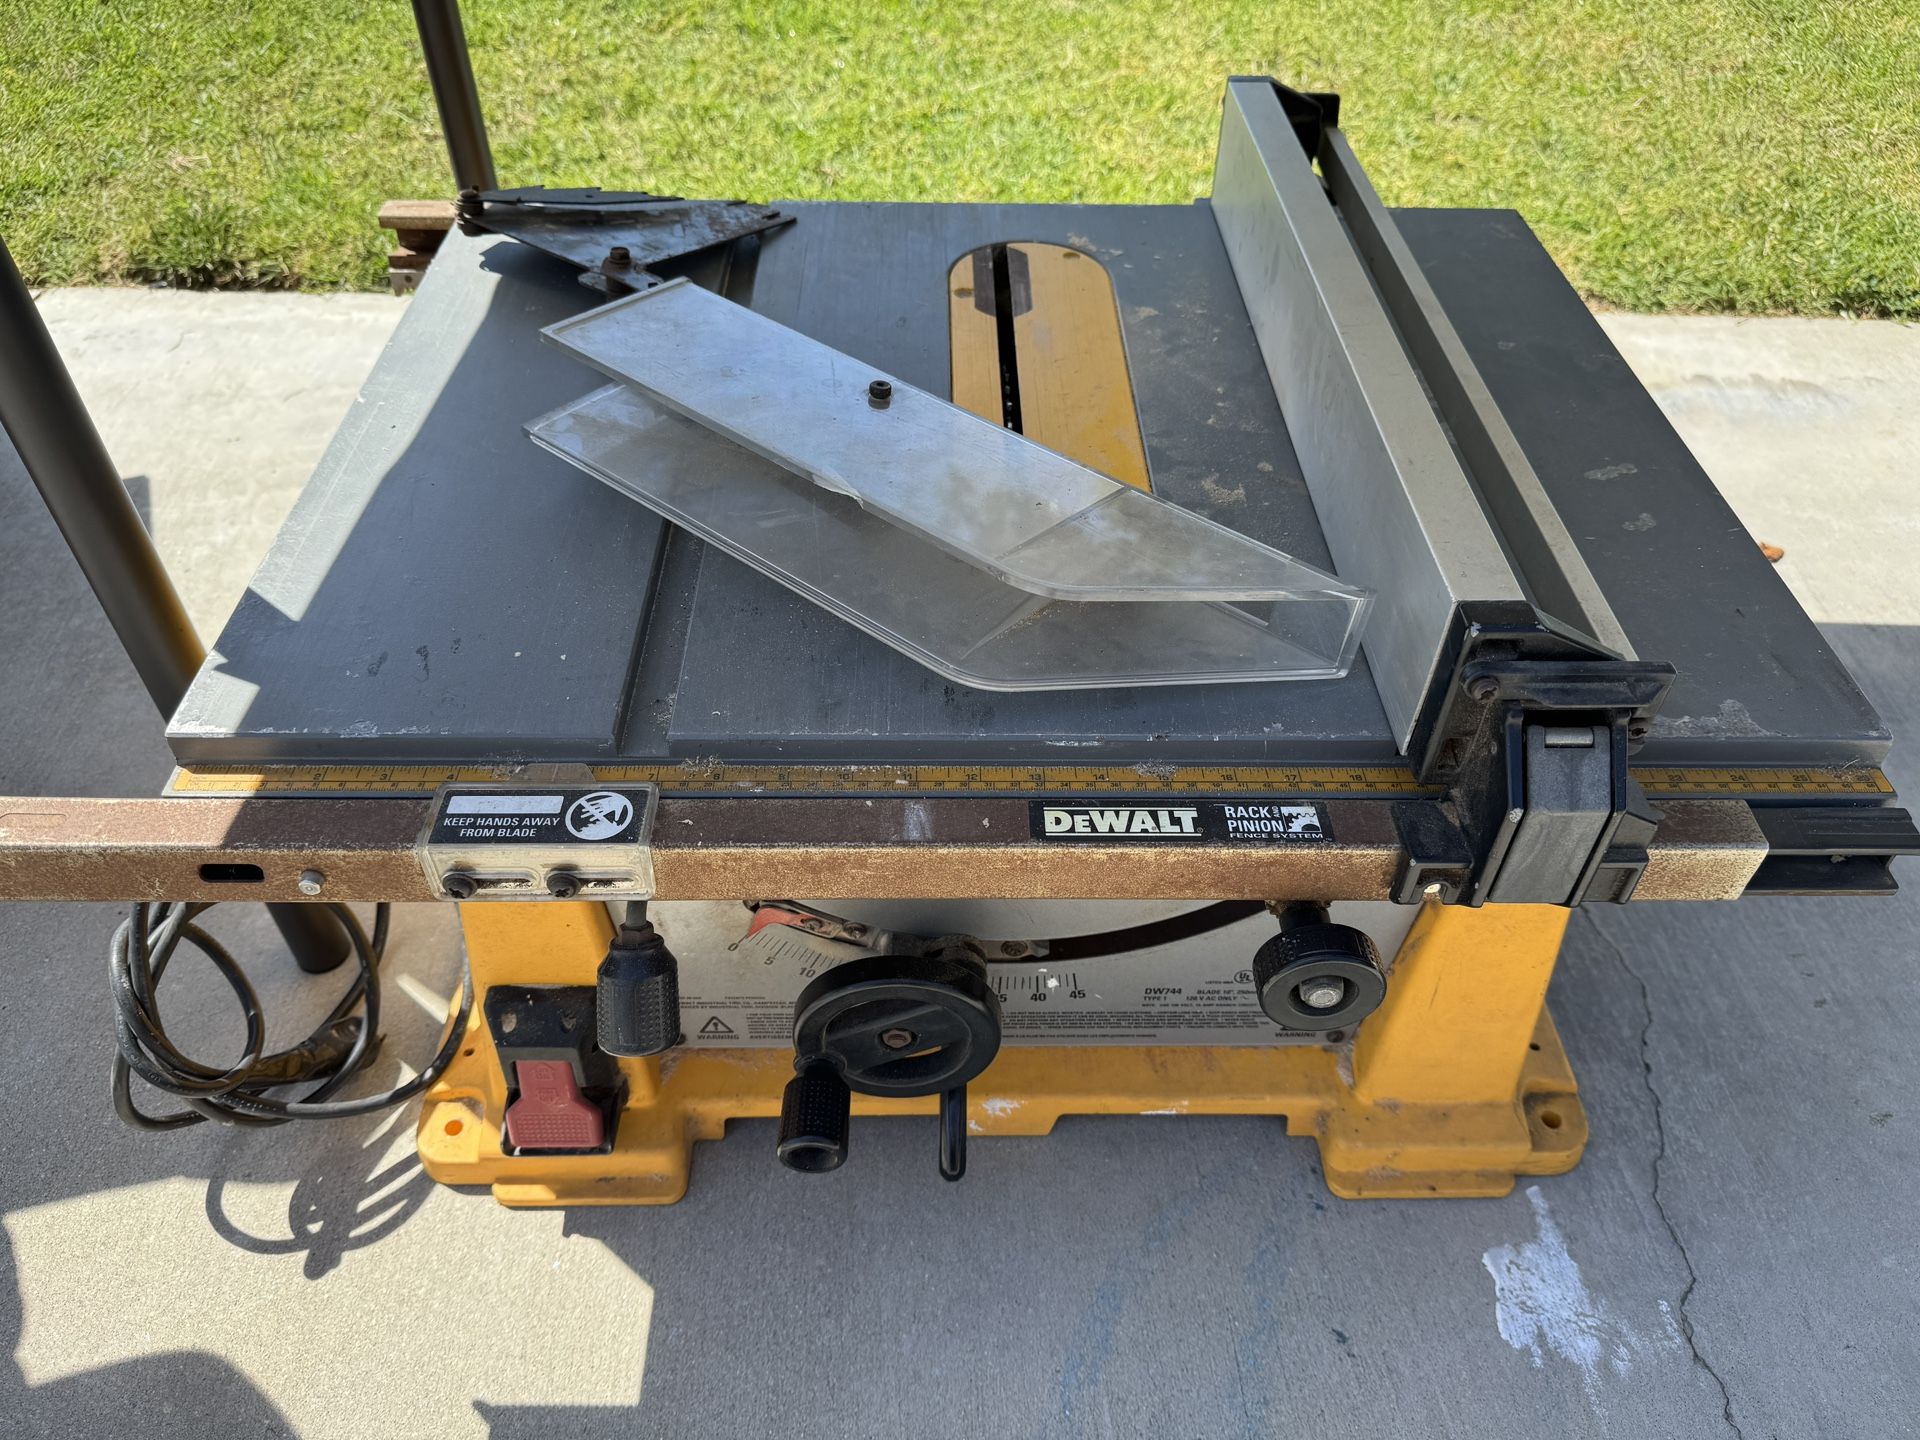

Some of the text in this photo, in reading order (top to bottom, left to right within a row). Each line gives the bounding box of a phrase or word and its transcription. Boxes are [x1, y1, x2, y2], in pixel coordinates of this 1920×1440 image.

[380, 773, 388, 781] 3
[648, 773, 655, 781] 7
[965, 773, 978, 781] 12
[1028, 773, 1042, 781] 13
[1093, 773, 1105, 781] 14
[1667, 774, 1683, 782] 23
[1730, 774, 1746, 782] 24
[1224, 806, 1271, 818] RACK
[444, 817, 561, 826] KEEP HANDS AWAY
[1228, 820, 1284, 832] PINION
[460, 828, 538, 837] FROM BLADE
[727, 942, 816, 978] 0 5 10
[996, 990, 1086, 1002] 5 40 45
[1144, 987, 1182, 995] DW744
